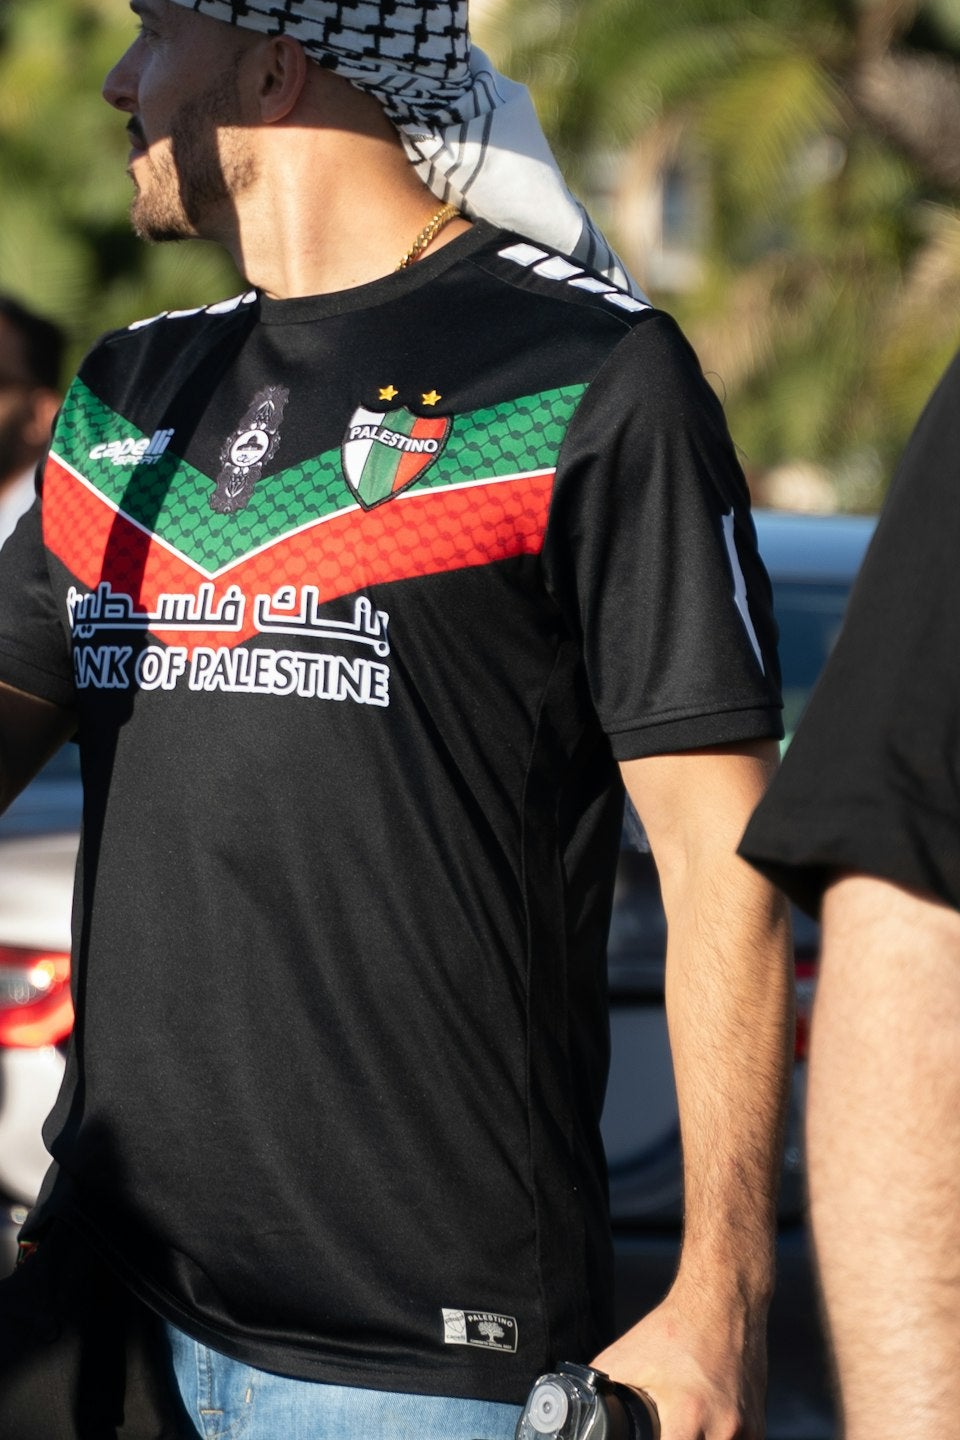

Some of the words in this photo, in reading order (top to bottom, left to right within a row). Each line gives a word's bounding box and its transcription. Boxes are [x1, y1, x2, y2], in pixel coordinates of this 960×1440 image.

[88, 428, 175, 460] capelli
[349, 424, 439, 453] PALESTINO
[253, 584, 390, 658] بنك
[73, 645, 134, 690] ANK
[135, 645, 188, 691] OF
[189, 646, 390, 708] PALESTINE
[467, 1313, 513, 1328] PALESTINO
